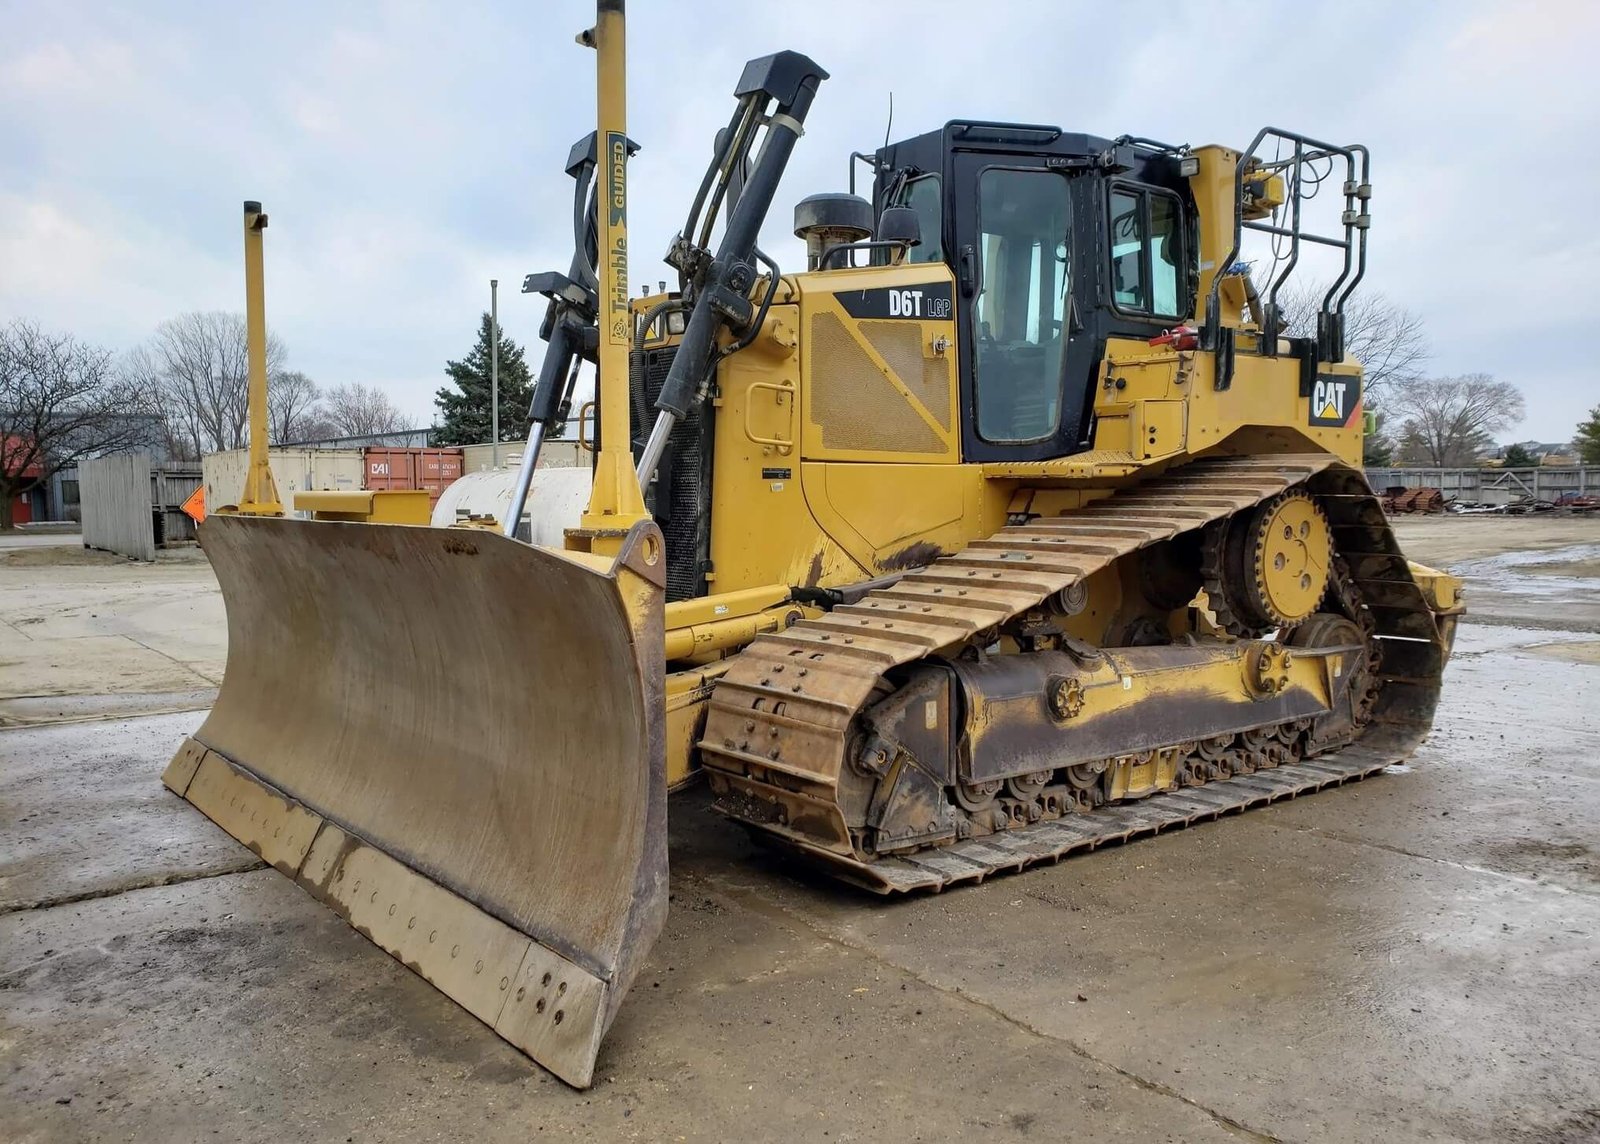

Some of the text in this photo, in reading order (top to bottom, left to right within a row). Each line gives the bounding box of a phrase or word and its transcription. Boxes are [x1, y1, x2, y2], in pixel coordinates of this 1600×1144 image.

[611, 141, 627, 313] Trimble GUIDED
[889, 289, 952, 318] D6T LGP
[1313, 380, 1346, 419] CAT
[371, 463, 389, 474] CAI
